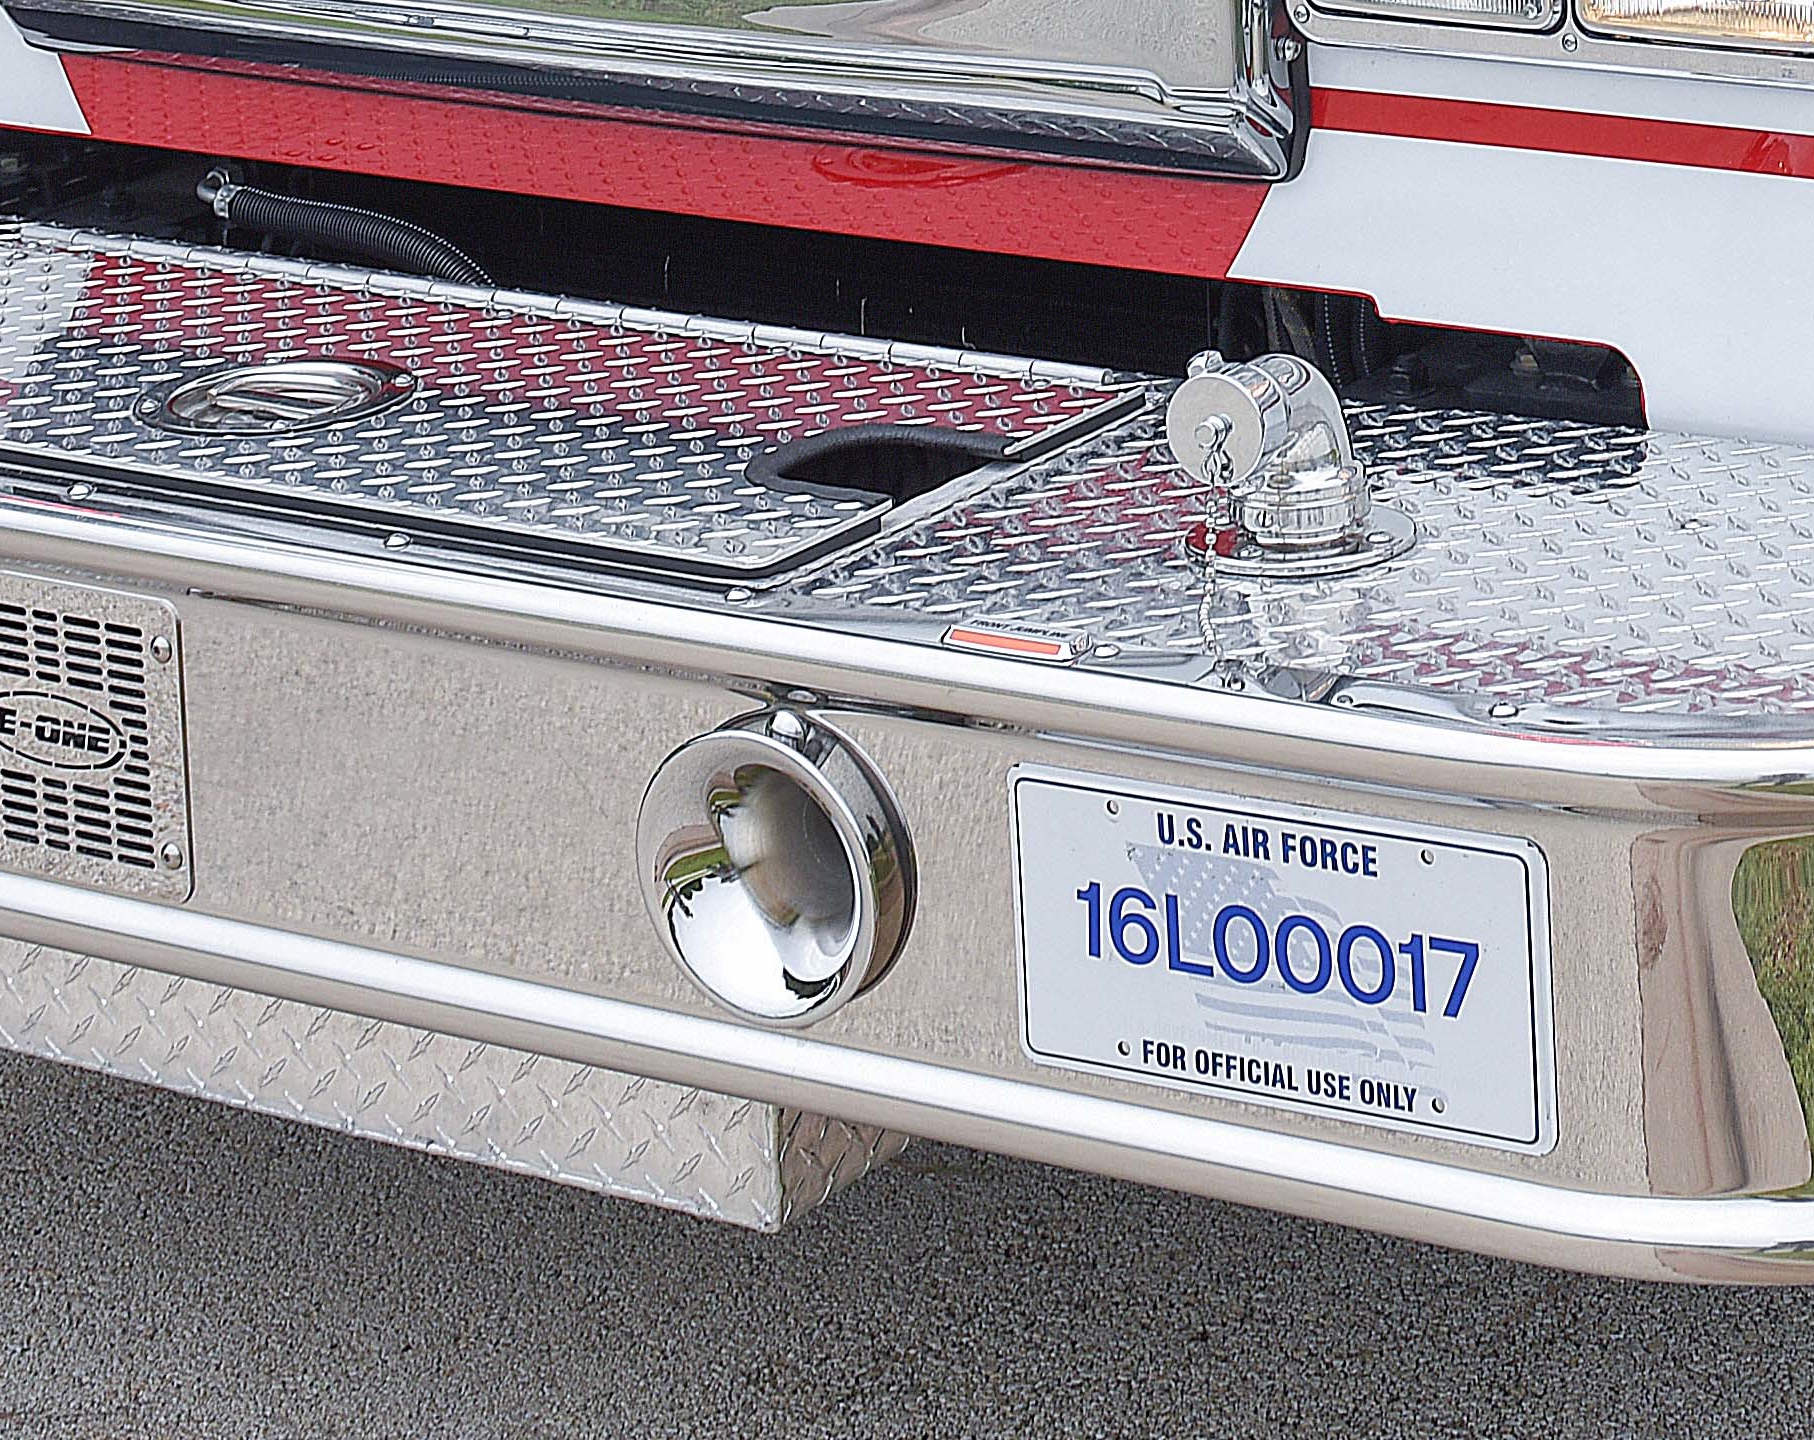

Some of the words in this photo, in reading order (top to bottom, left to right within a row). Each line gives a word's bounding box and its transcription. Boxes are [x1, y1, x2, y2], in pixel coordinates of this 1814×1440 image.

[1157, 812, 1213, 852] U.S.
[1222, 823, 1271, 862] AIR
[1281, 832, 1378, 877] FORCE
[1076, 880, 1480, 1020] 16L00017
[1142, 1039, 1187, 1073] FOR
[1194, 1048, 1299, 1093] OFFICIAL
[1306, 1067, 1351, 1102] USE
[1359, 1078, 1418, 1114] ONLY
